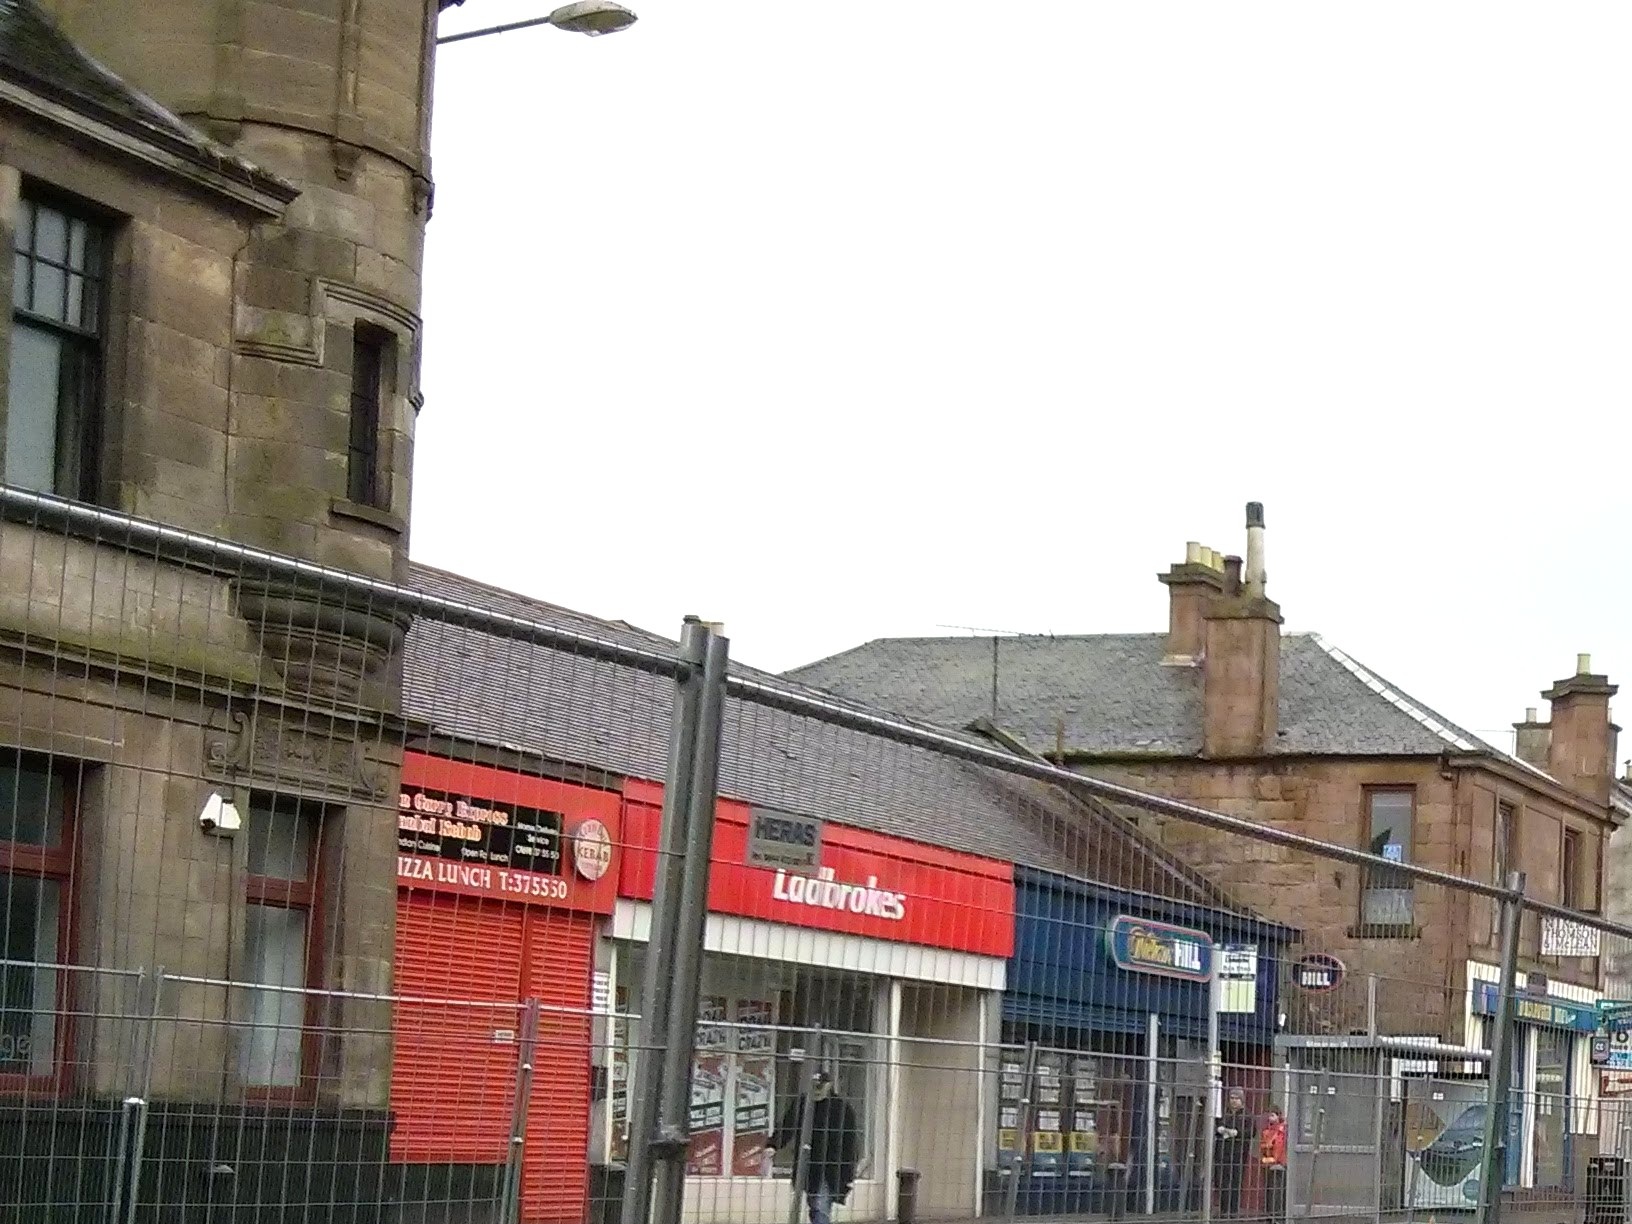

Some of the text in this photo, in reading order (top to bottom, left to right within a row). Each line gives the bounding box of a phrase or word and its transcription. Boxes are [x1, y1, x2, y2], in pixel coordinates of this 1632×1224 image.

[399, 814, 437, 835] anbul
[397, 856, 568, 900] IZZA LUNCH T:375550
[773, 867, 907, 920] Ladbrokes
[1301, 971, 1331, 986] HILL
